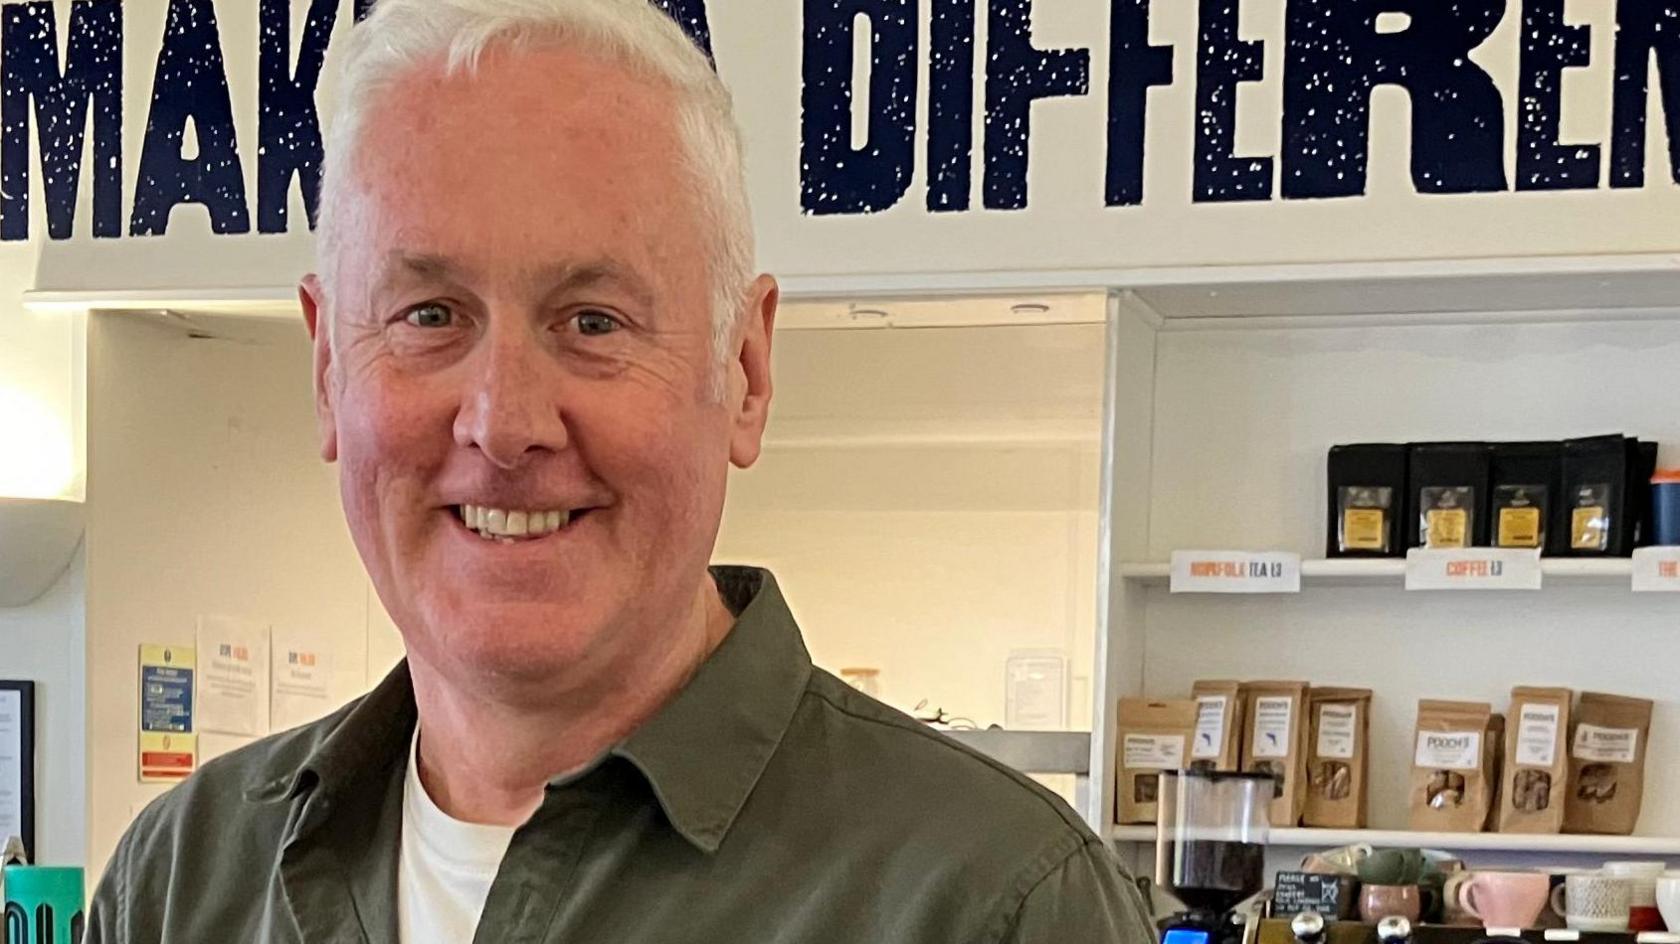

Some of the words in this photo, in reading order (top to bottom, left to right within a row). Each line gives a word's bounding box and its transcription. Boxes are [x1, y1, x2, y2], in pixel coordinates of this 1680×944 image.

[0, 0, 376, 241] MAK
[1248, 561, 1268, 578] TEA
[1446, 560, 1489, 577] COFFEE
